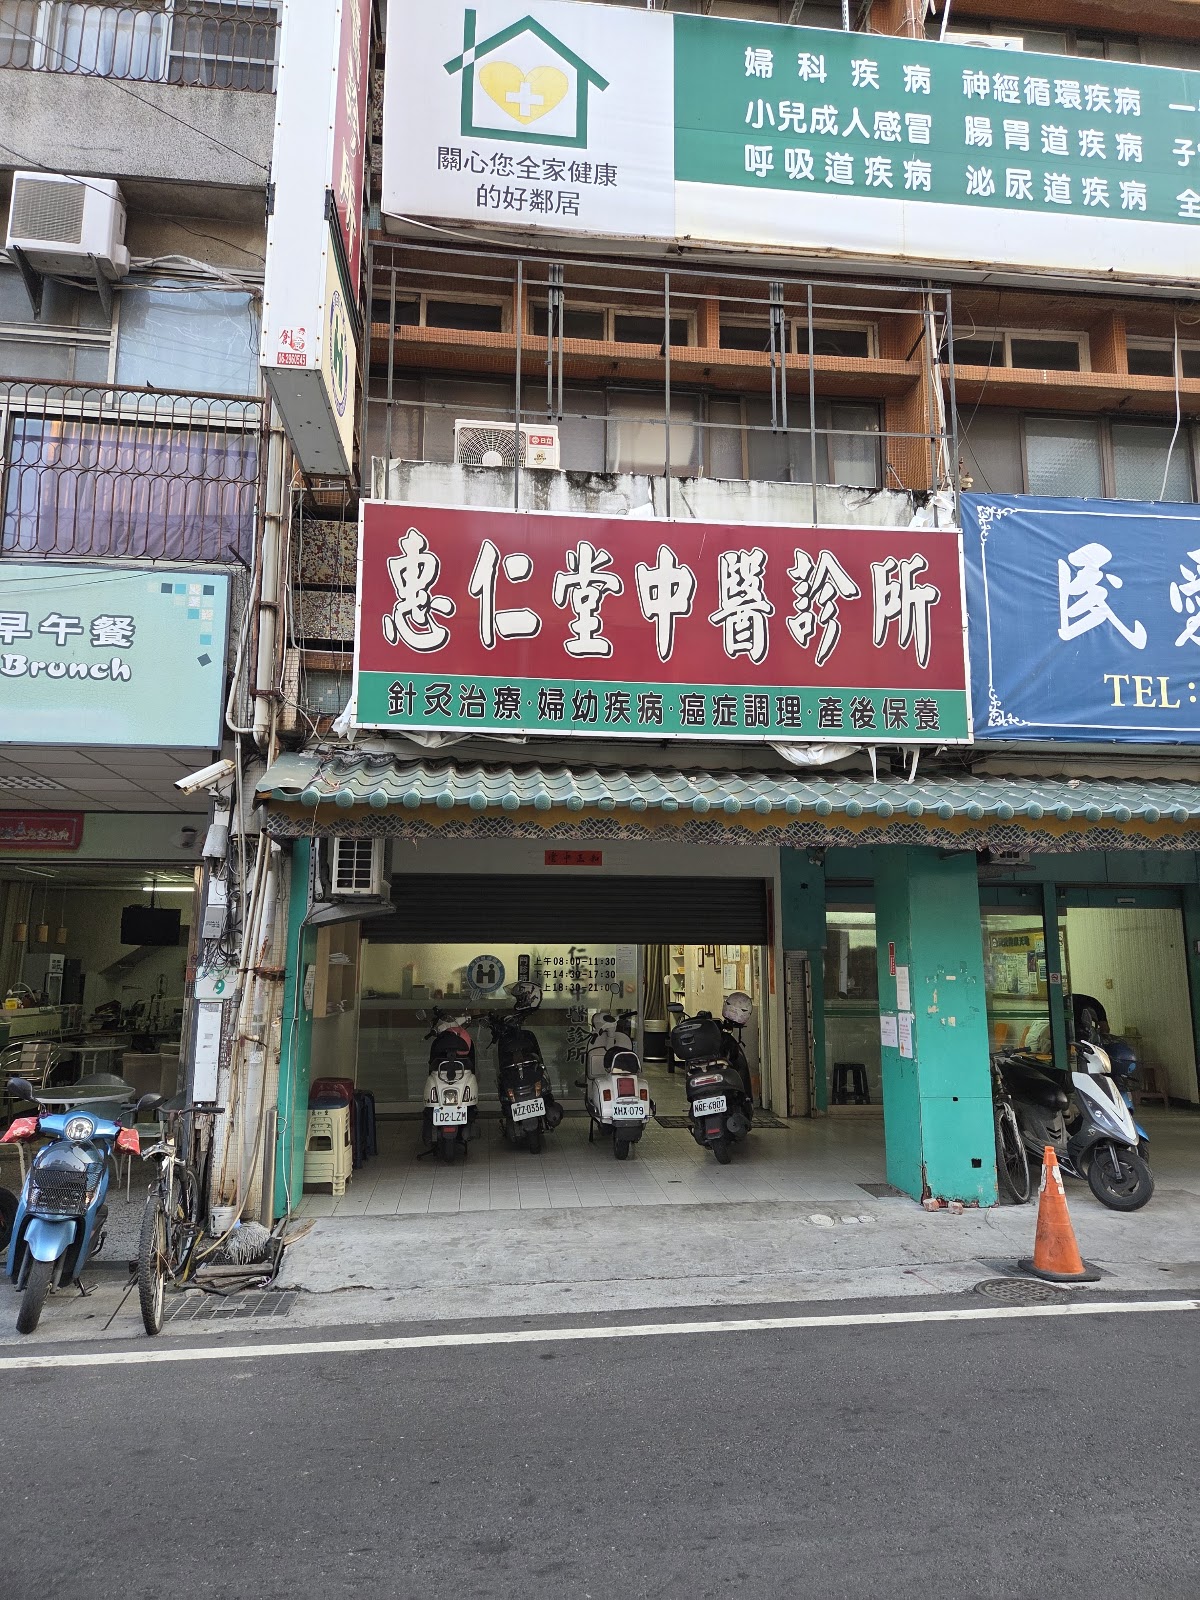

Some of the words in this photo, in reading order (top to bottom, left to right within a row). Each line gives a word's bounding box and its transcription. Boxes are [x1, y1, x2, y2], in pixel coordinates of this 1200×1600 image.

[744, 46, 931, 96] 婦科疾病
[961, 69, 1142, 118] 神經循環疾病
[745, 98, 932, 145] 小兒成人感冒
[963, 114, 1143, 163] 腸胃道疾病
[1172, 138, 1200, 167] 子
[437, 146, 618, 187] 關心您全家健康
[744, 144, 932, 193] 呼吸道疾病
[965, 164, 1147, 212] 泌尿道疾病
[476, 183, 580, 217] 的好鄰居
[383, 527, 940, 669] 惠仁堂中醫診所
[0, 611, 136, 649] 早午餐
[0, 653, 132, 682] Brunch
[213, 979, 226, 995] 9
[543, 983, 610, 992] 上18:30-21:0
[566, 946, 592, 1064] 仁堂中醫診所
